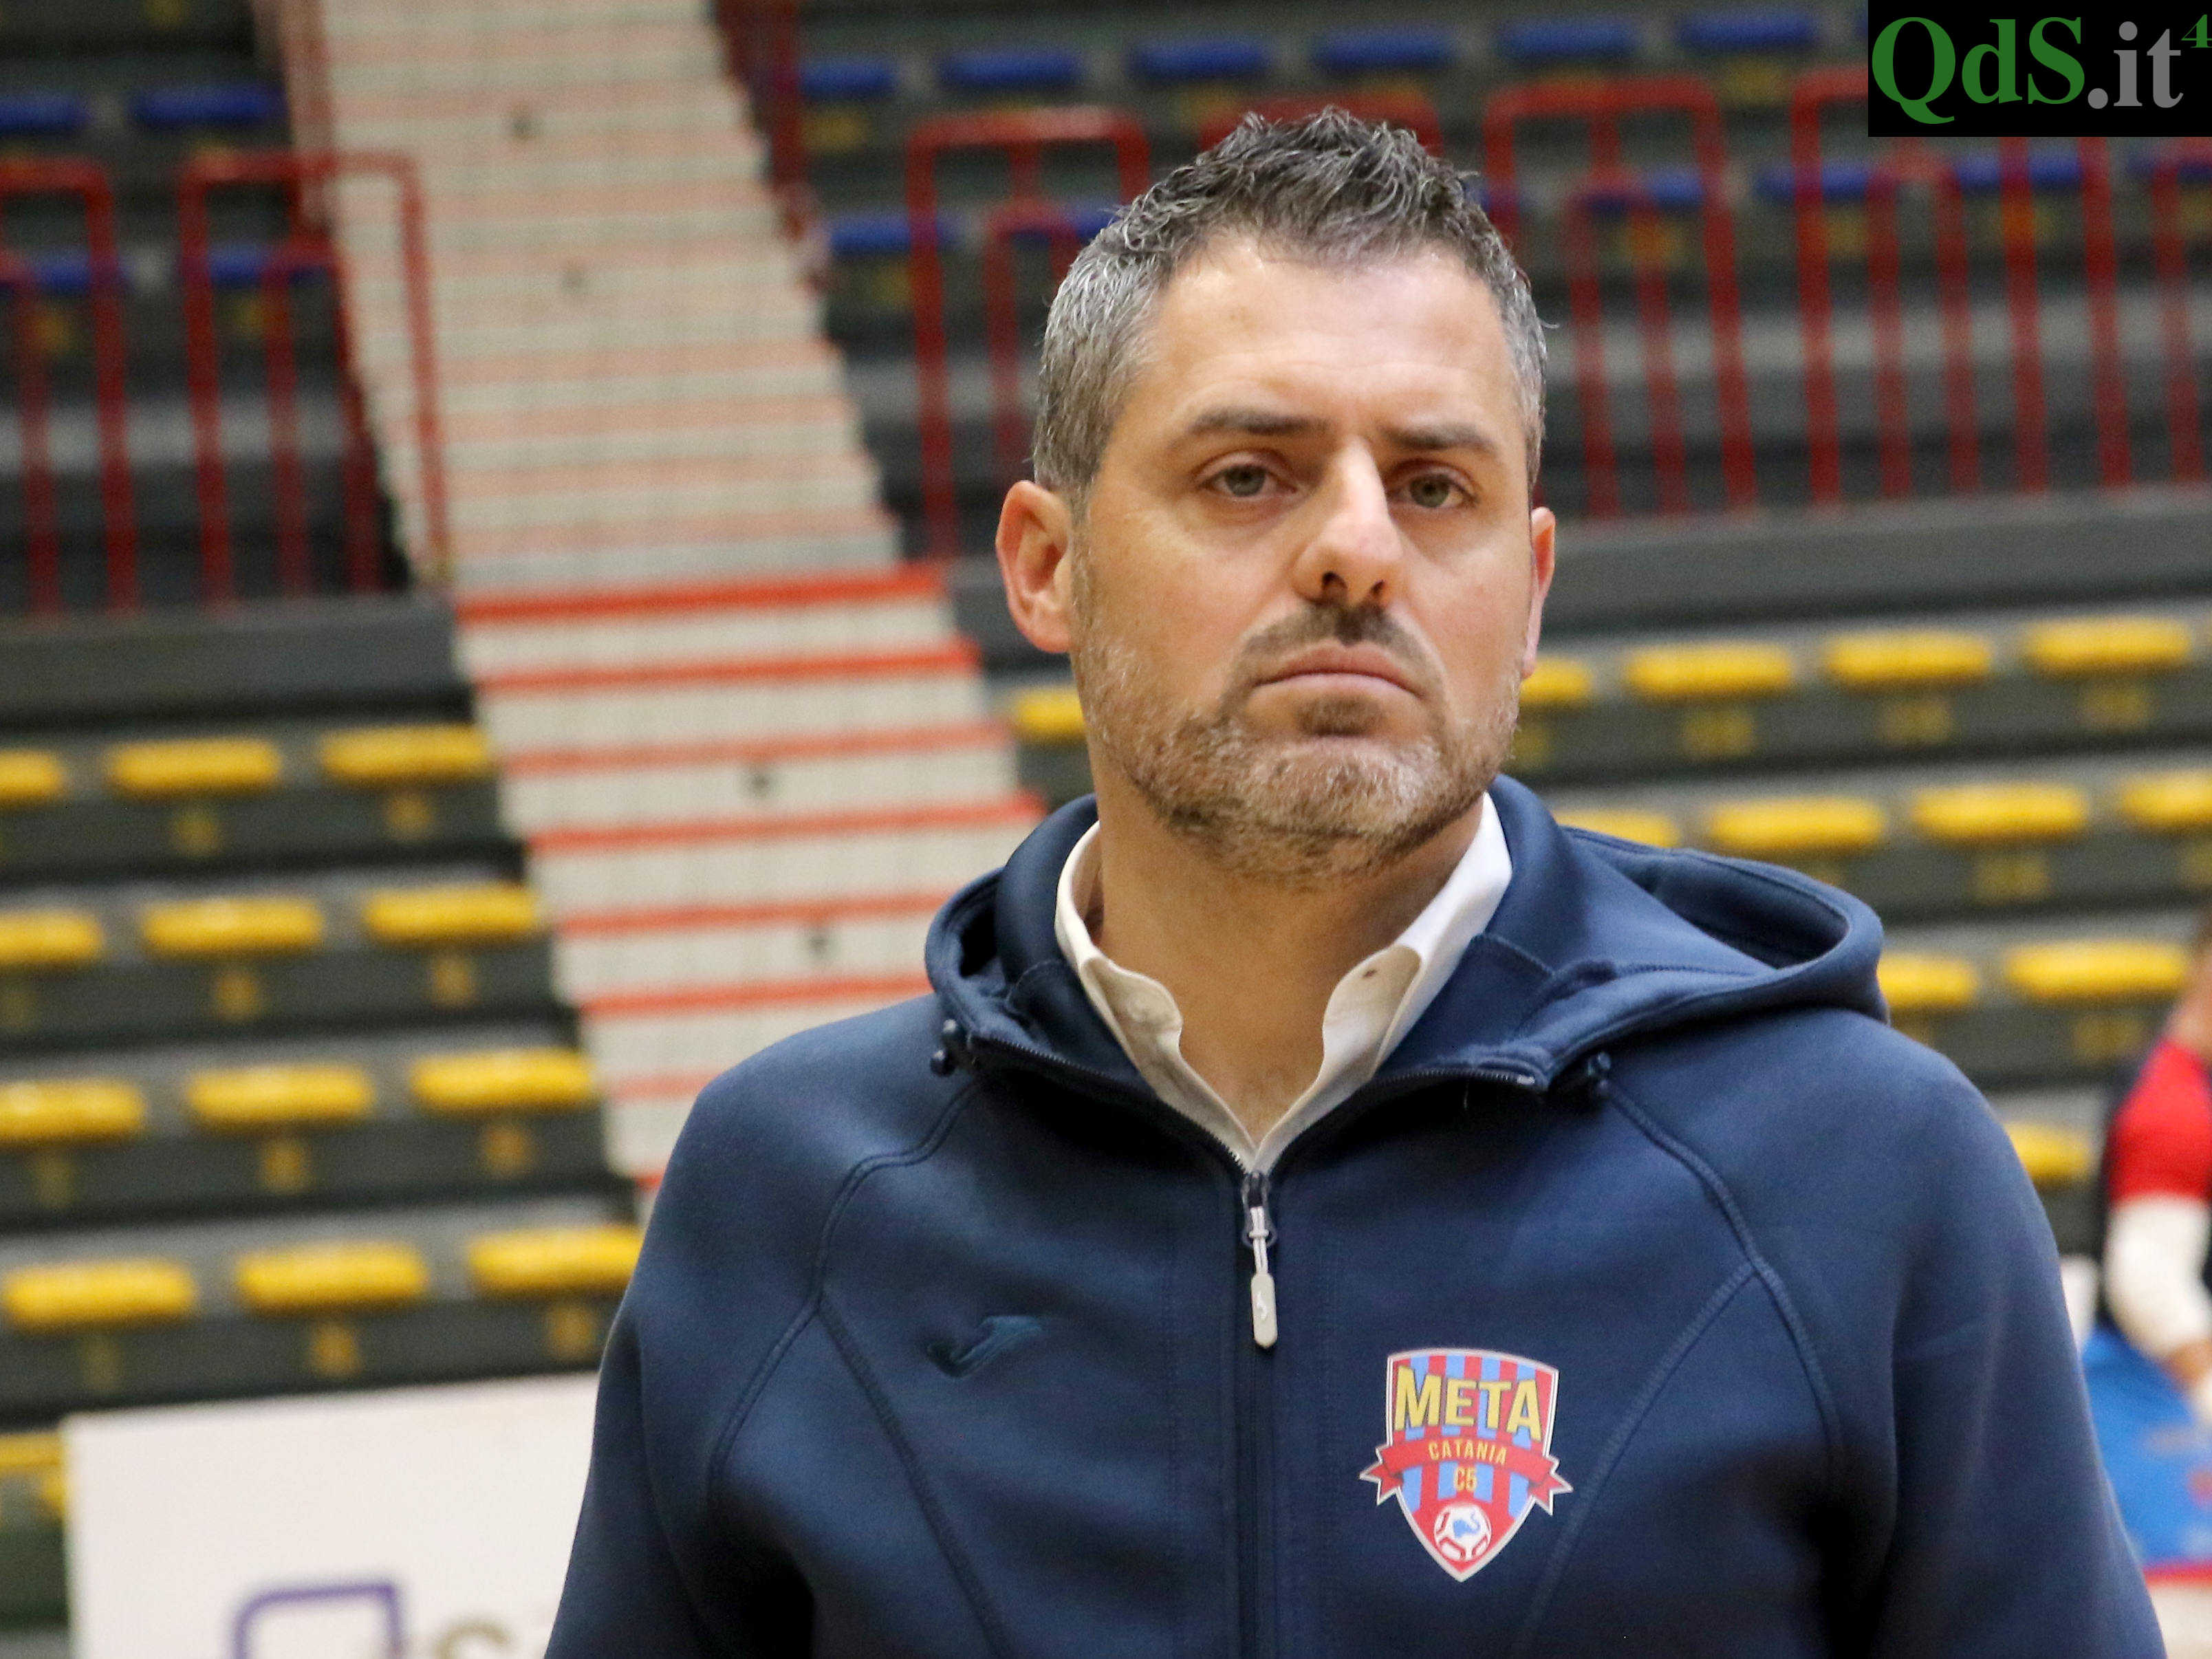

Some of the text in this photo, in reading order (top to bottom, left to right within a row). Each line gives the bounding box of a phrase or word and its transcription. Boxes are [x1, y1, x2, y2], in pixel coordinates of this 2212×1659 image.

[1394, 1365, 1542, 1442] META
[1428, 1438, 1507, 1466] CATANIA
[1453, 1466, 1477, 1492] C5
